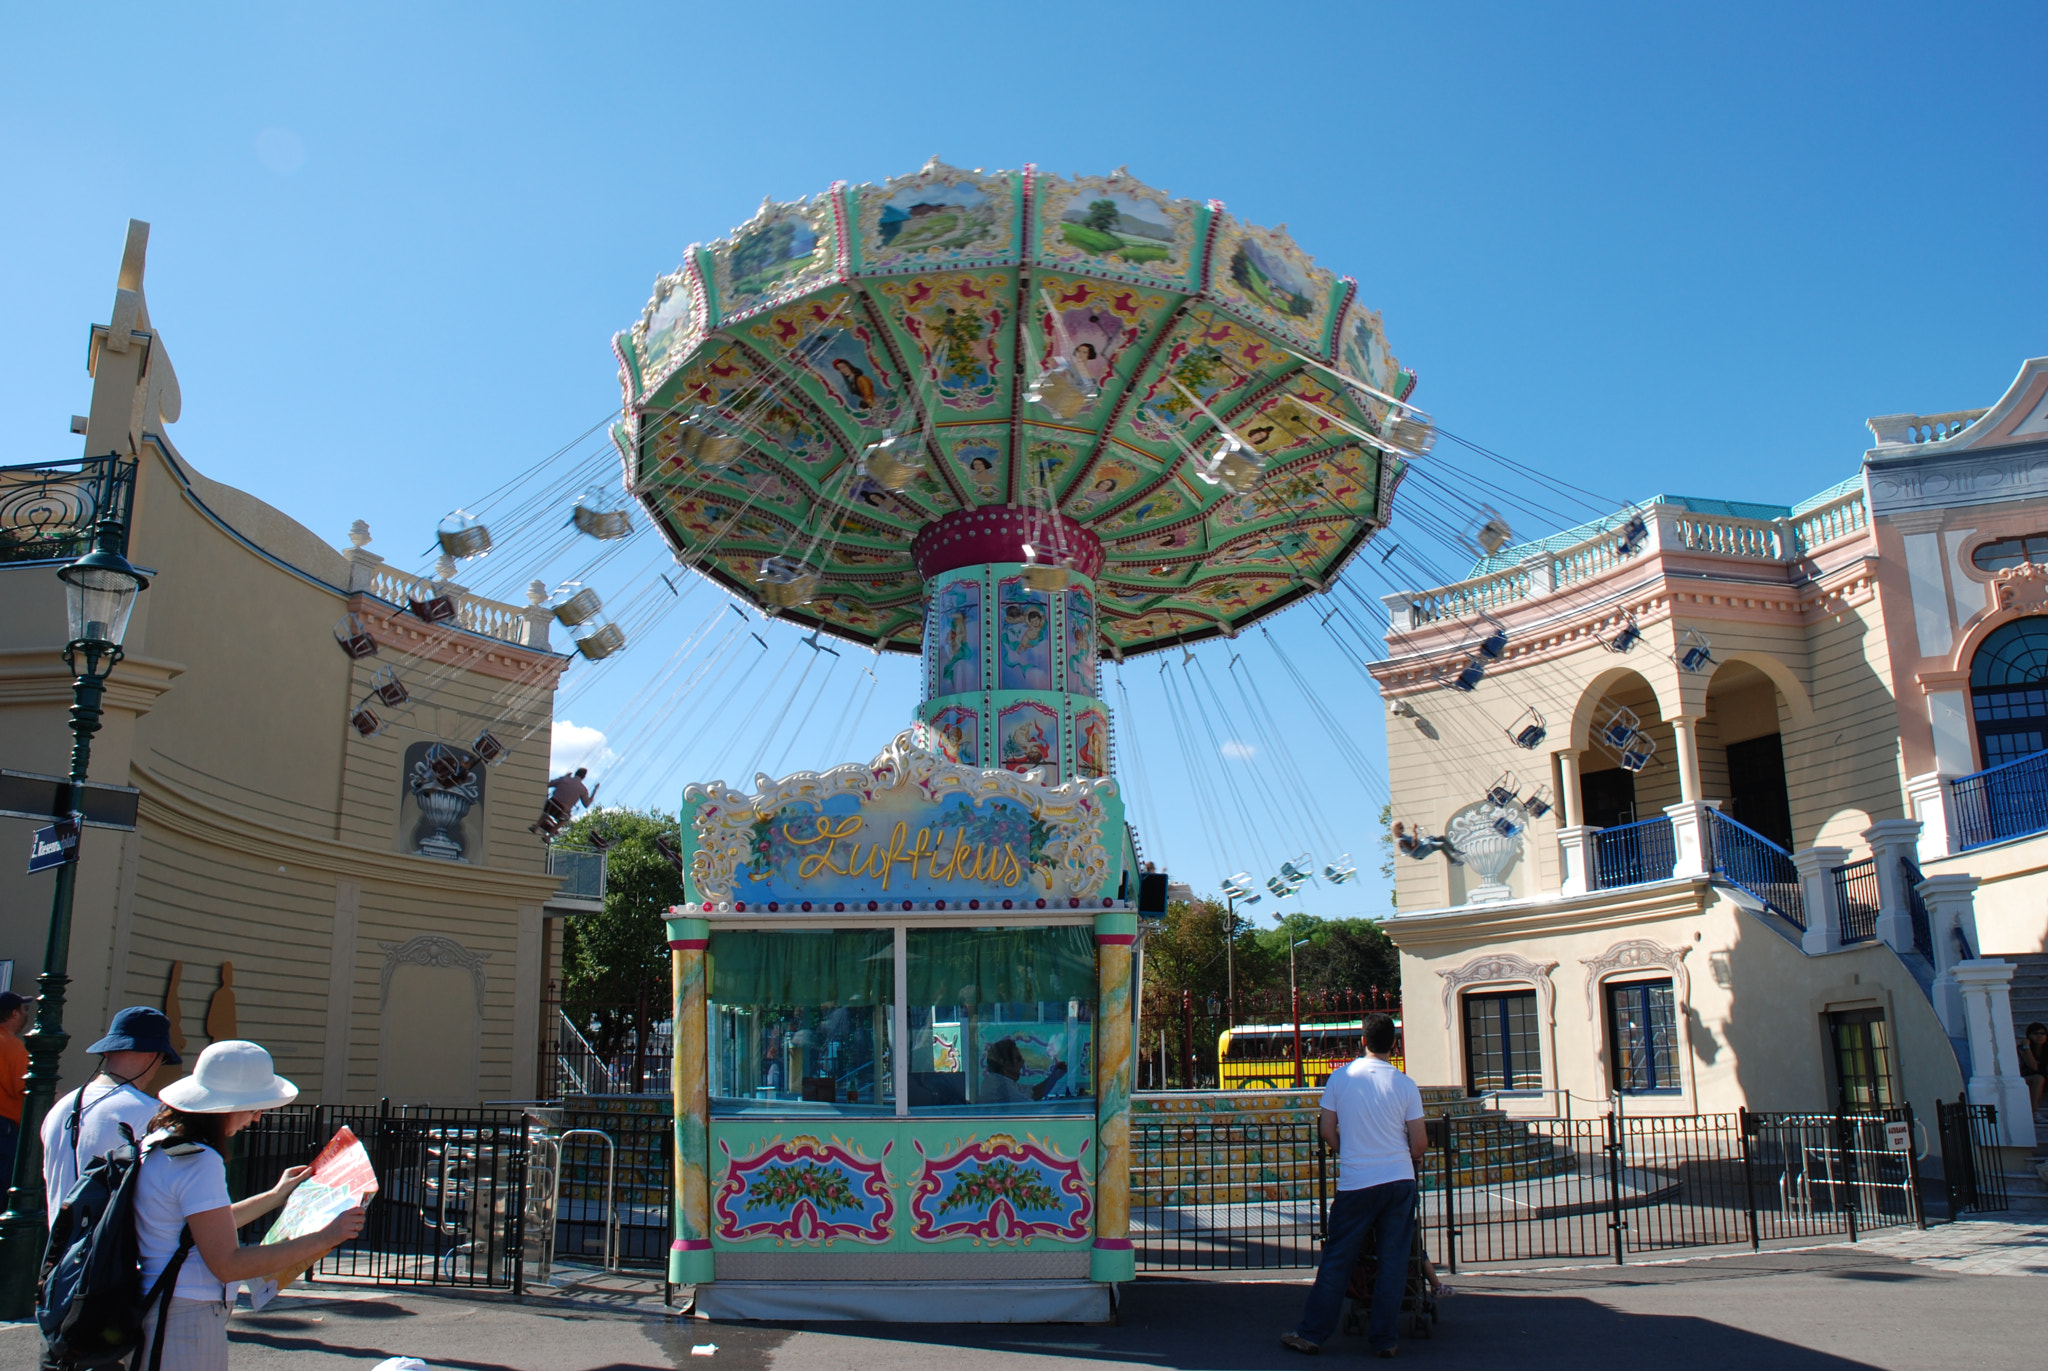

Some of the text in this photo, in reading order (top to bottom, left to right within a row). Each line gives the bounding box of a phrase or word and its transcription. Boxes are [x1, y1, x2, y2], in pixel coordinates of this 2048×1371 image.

[783, 815, 1021, 891] Luftikus
[1888, 1126, 1907, 1134] AUSGANG
[1894, 1137, 1904, 1145] EXIT
